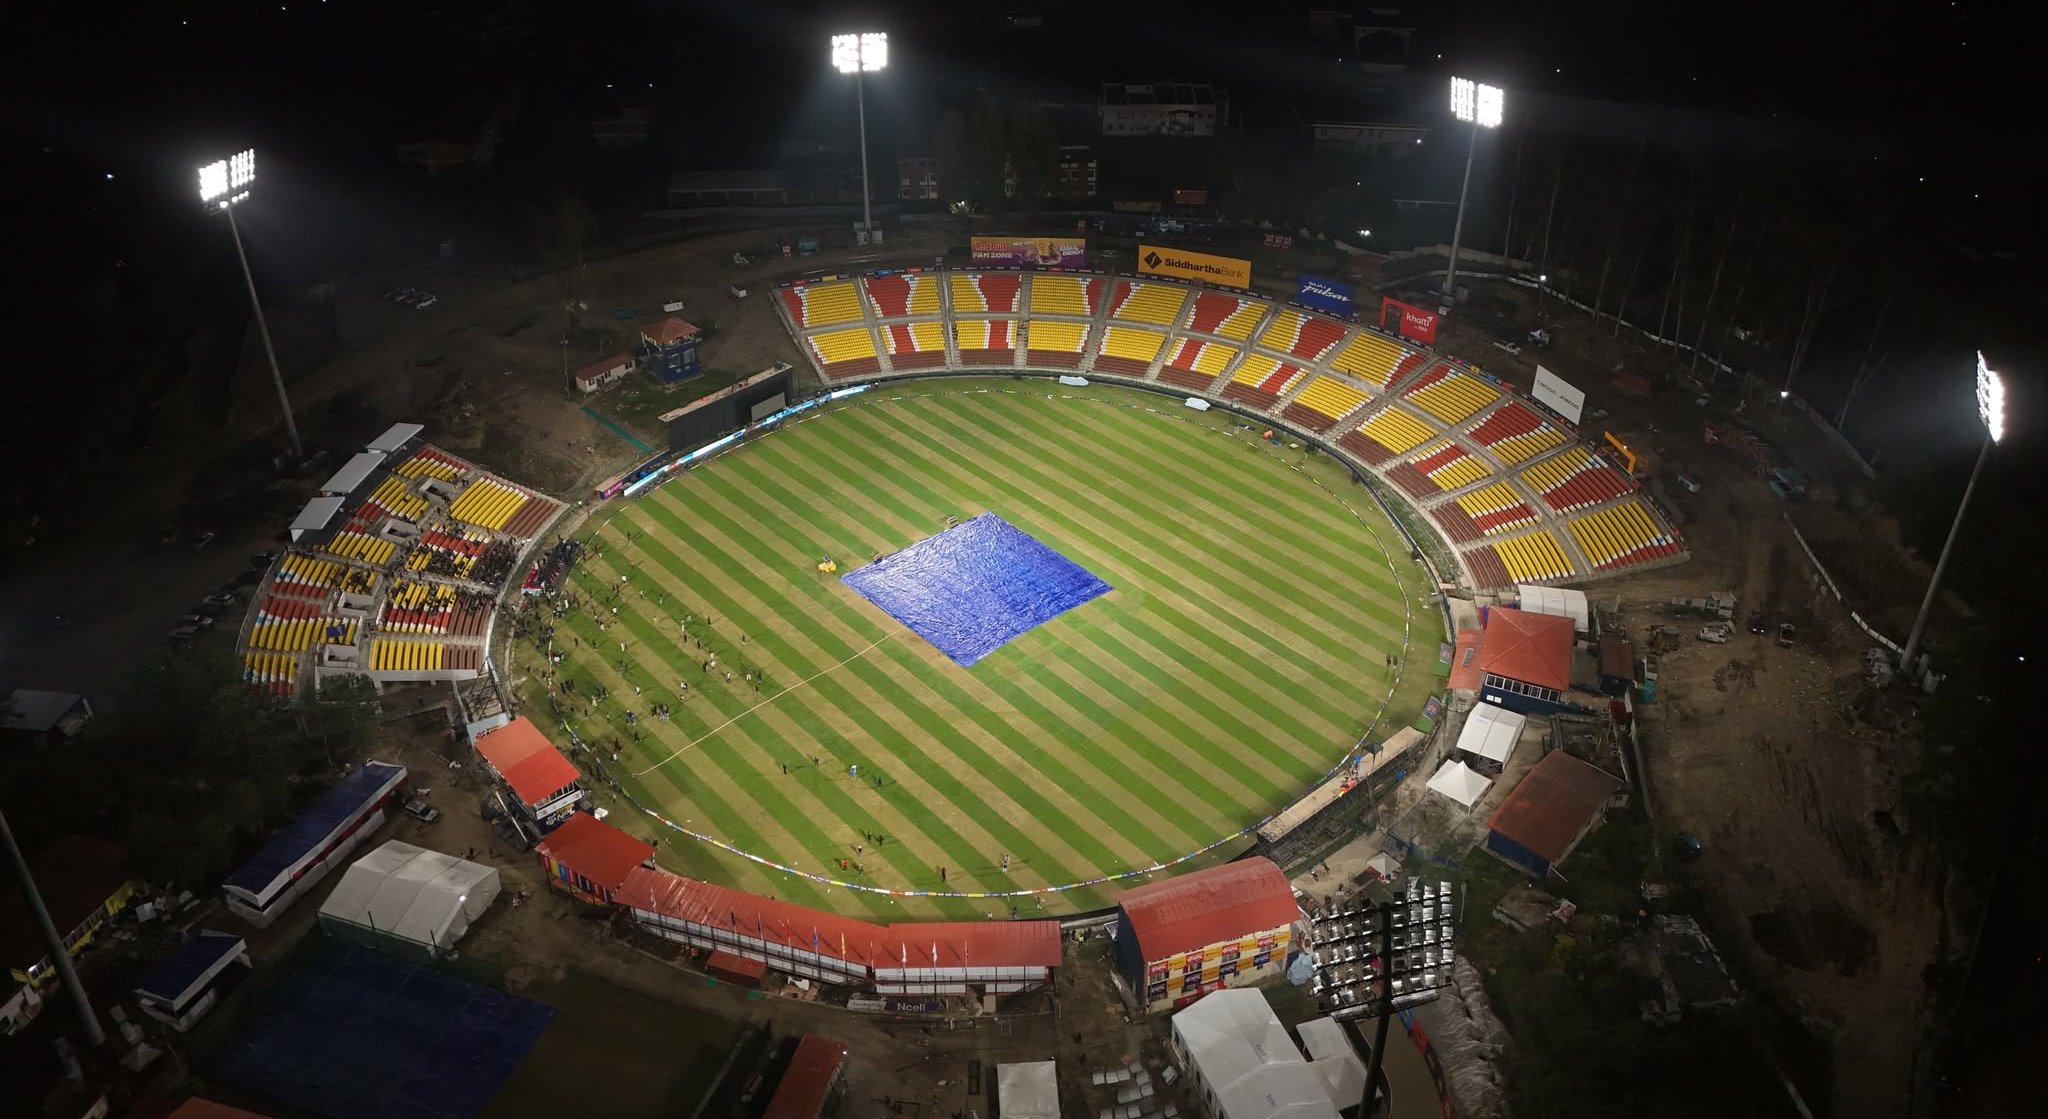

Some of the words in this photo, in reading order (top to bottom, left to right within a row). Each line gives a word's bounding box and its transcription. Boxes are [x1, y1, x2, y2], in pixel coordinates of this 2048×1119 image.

[975, 241, 990, 250] Red
[991, 241, 1008, 251] Bull
[972, 251, 989, 259] FAN
[990, 251, 1013, 259] ZONE
[1406, 312, 1431, 327] khalti
[897, 1002, 926, 1012] Ncell
